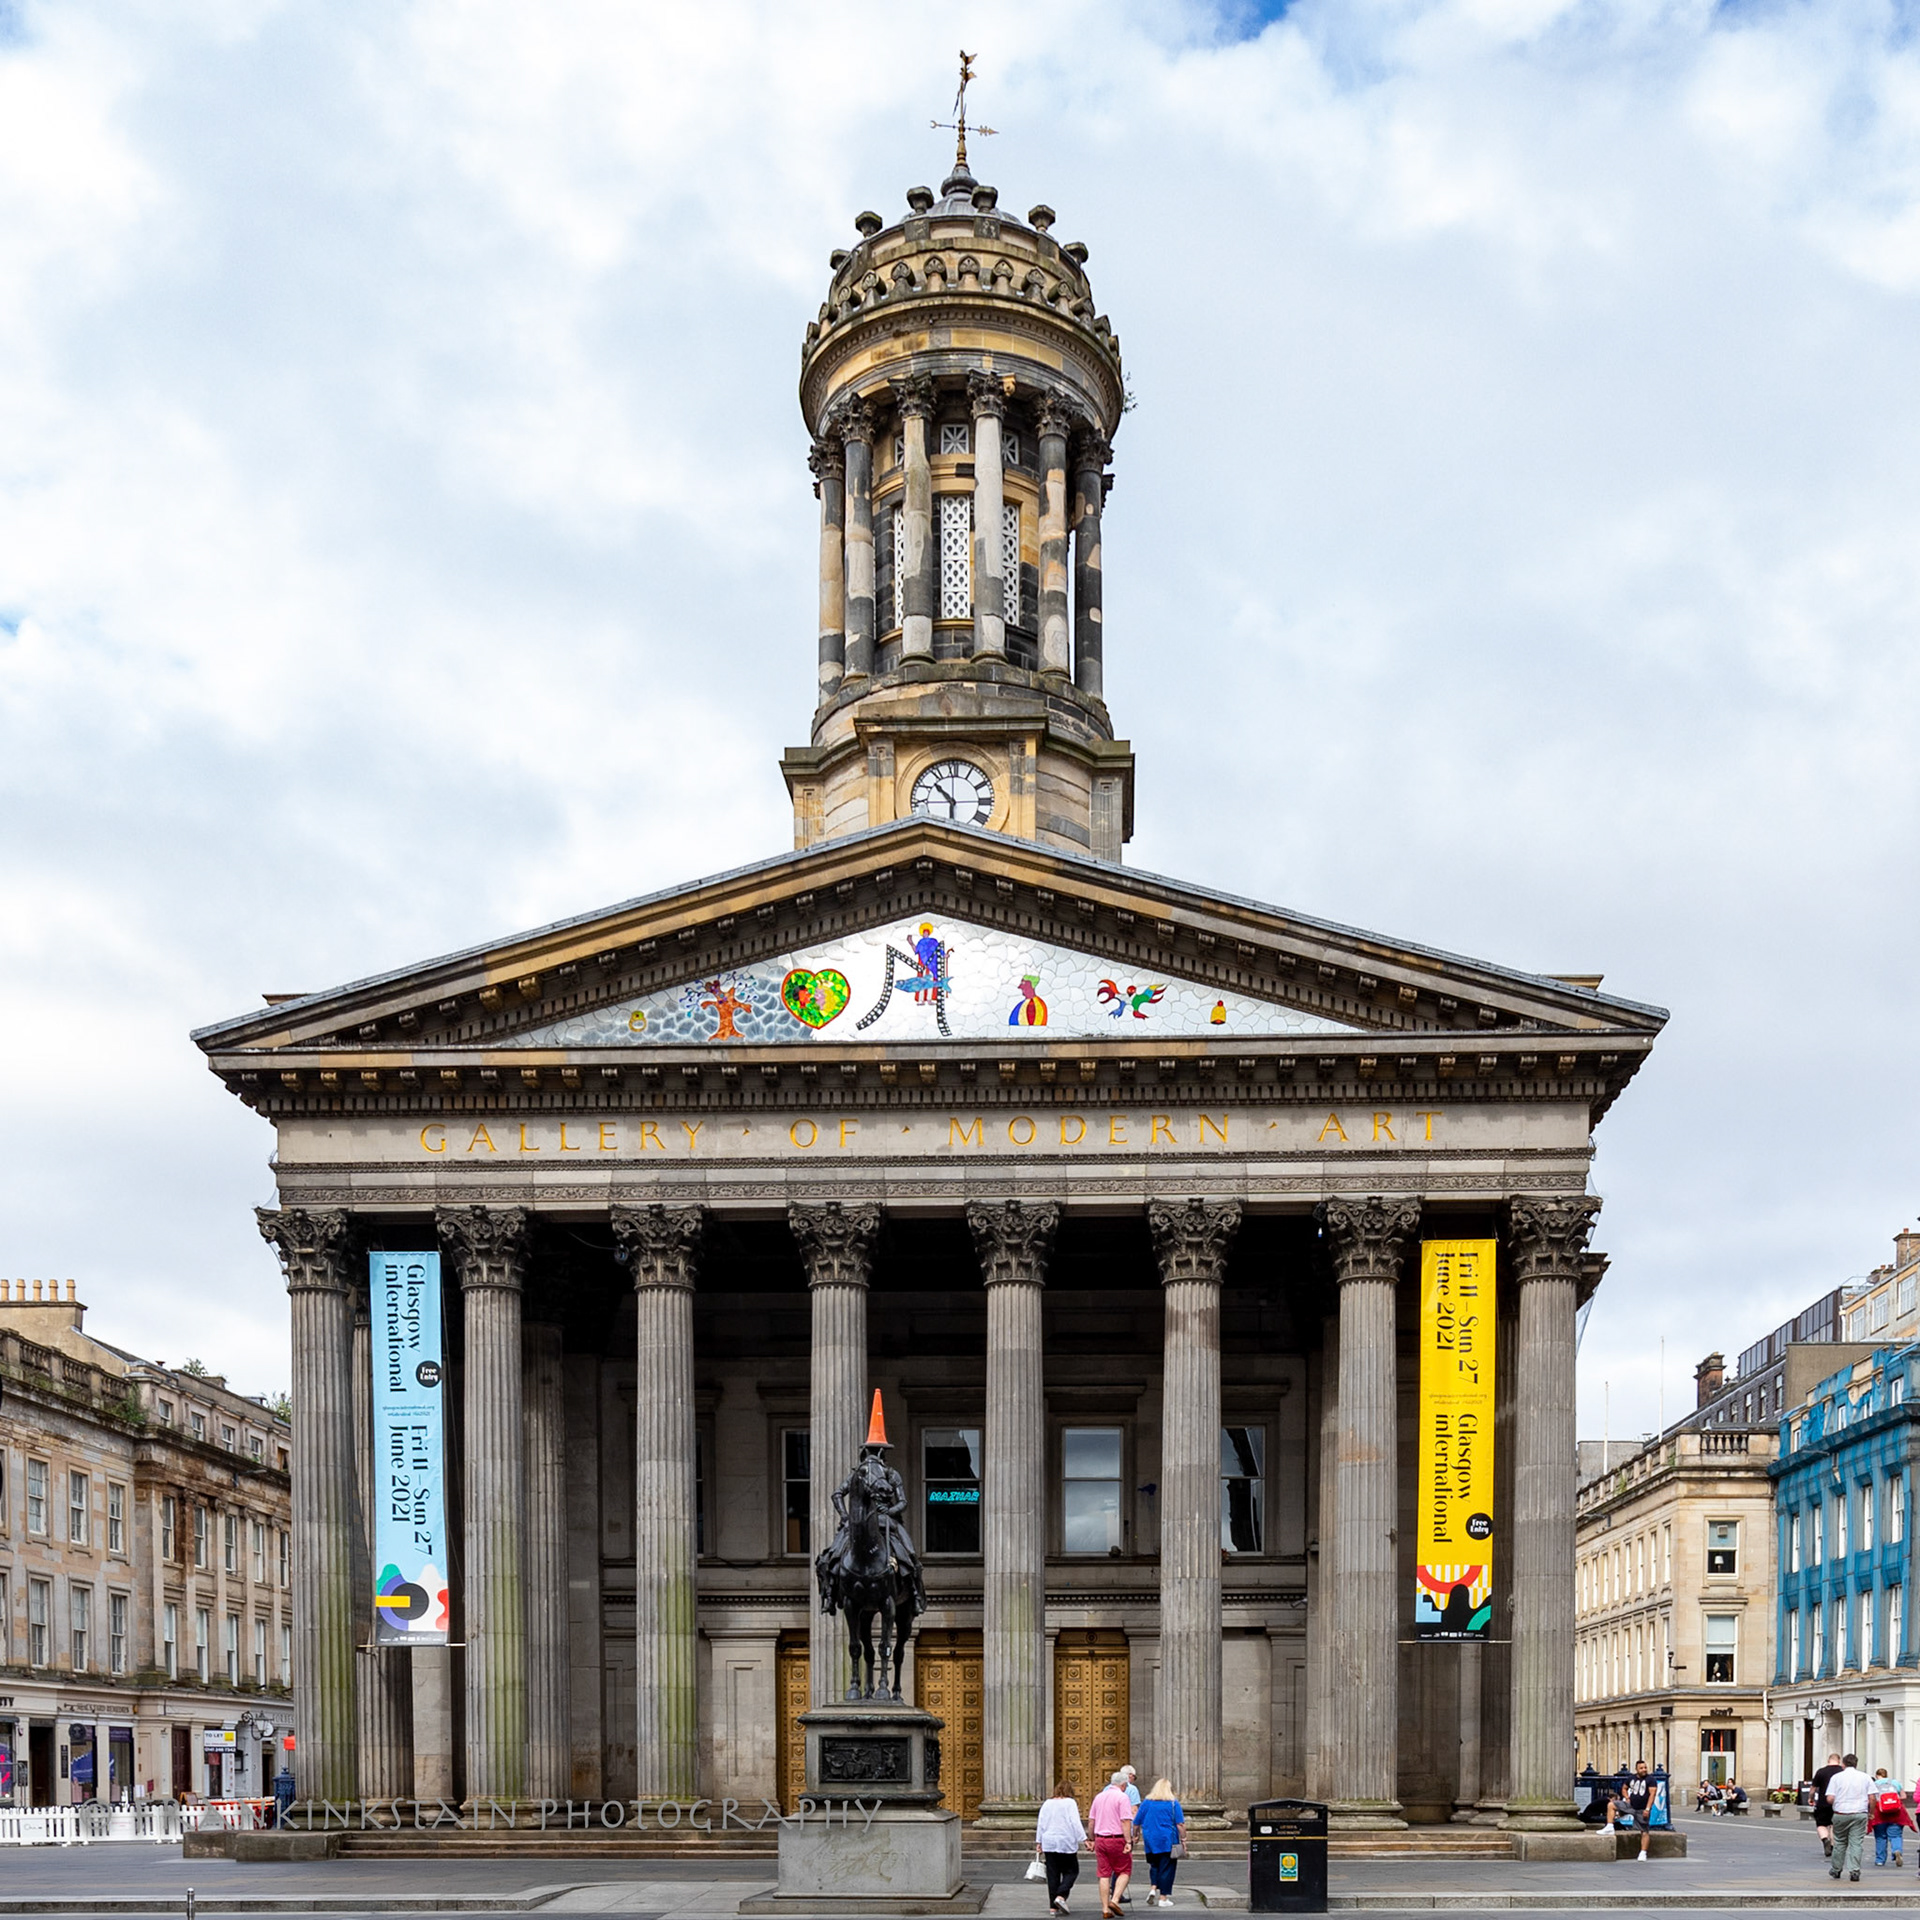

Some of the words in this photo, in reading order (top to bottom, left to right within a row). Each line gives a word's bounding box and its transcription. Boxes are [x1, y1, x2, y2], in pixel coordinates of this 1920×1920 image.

[420, 1120, 704, 1153] GALLERY
[789, 1118, 859, 1148] OF
[947, 1113, 1229, 1146] MODERN
[1317, 1110, 1443, 1142] ART
[1435, 1252, 1455, 1296] June
[1459, 1252, 1479, 1278] Fri
[385, 1264, 407, 1393] international
[401, 1264, 425, 1352] Glasgow
[1436, 1302, 1455, 1351] 2021
[1459, 1316, 1479, 1353] Sun
[1459, 1360, 1479, 1384] 27
[389, 1425, 409, 1468] June
[411, 1425, 428, 1451] Fri
[1450, 1413, 1479, 1503] Glasgow
[391, 1474, 411, 1522] 2021
[1433, 1413, 1454, 1543] international
[413, 1488, 431, 1526] Sun
[415, 1531, 432, 1556] 27
